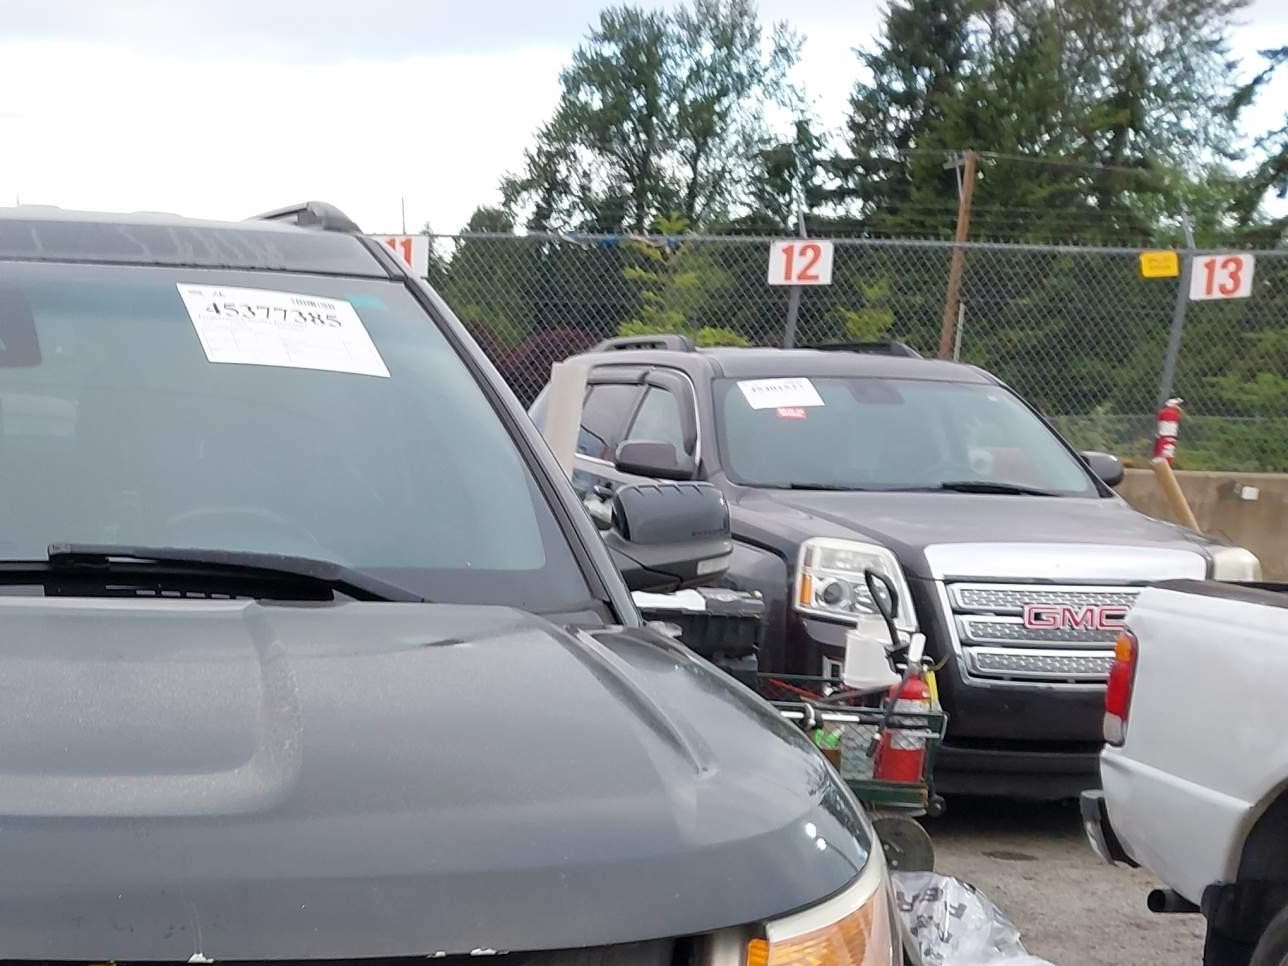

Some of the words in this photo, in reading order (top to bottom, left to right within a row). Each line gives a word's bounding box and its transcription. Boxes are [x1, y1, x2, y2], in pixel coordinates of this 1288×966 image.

[782, 244, 822, 281] 12
[1204, 256, 1243, 297] 13
[206, 302, 342, 328] 45377385
[1024, 604, 1130, 631] GMC
